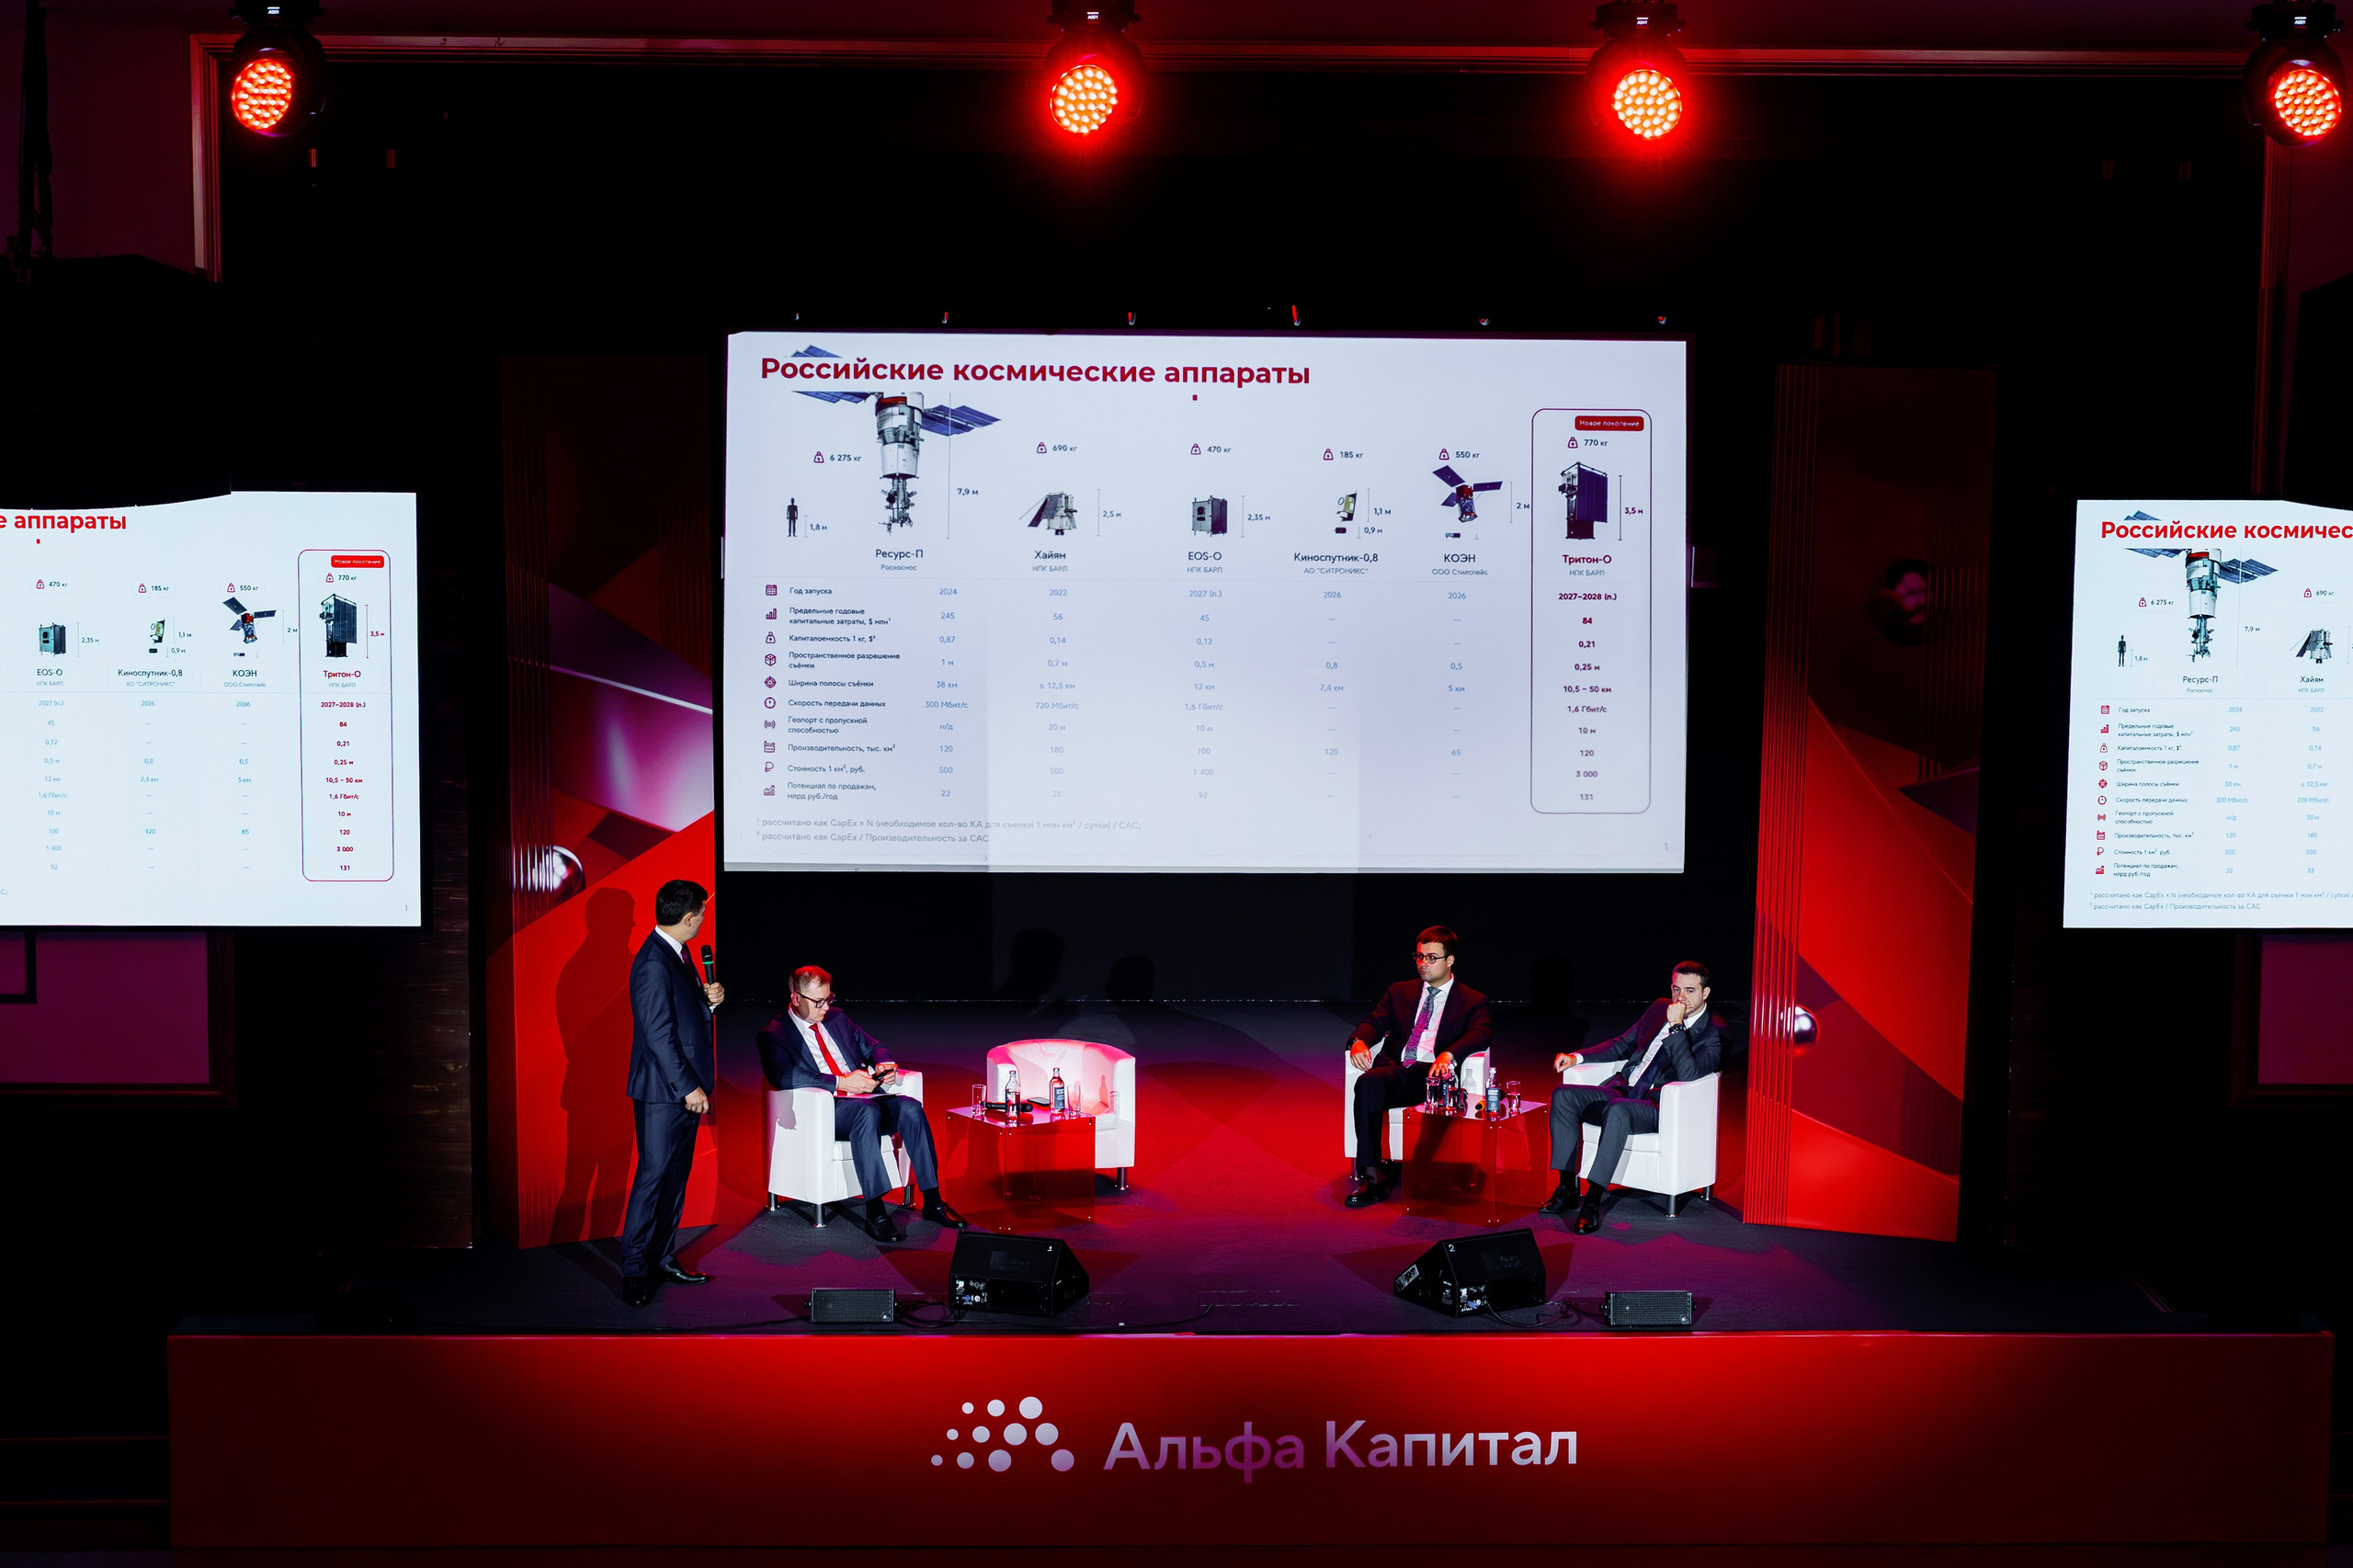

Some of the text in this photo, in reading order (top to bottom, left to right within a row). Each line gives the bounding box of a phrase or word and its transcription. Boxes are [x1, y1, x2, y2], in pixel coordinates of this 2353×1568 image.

[761, 357, 1310, 389] Российские космические аппараты
[1584, 438, 1599, 447] 770
[1051, 444, 1068, 452] 690
[1207, 445, 1222, 453] 470
[836, 454, 852, 462] 275
[1339, 450, 1354, 459] 185
[1455, 450, 1471, 459] 550
[957, 487, 971, 496] 7,9
[1102, 510, 1115, 518] 2,5
[1624, 506, 1637, 516] 3,5
[1247, 513, 1264, 522] 2,35
[14, 516, 127, 534] аппараты
[2101, 520, 2353, 540] Российские космичес
[875, 549, 924, 561] Ресурс-П
[1034, 550, 1066, 560] Хайям
[1188, 551, 1222, 562] EOS-O
[1293, 552, 1379, 564] Киноспутник-0,8
[1444, 553, 1476, 563] КОЭН
[1562, 554, 1612, 566] Тритон-О
[1451, 568, 1488, 576] Стилспейс
[1586, 569, 1605, 578] БАРЛ
[789, 586, 833, 597] Год запуска
[938, 587, 958, 596] 2024
[1049, 588, 1068, 597] 2022
[1188, 589, 1208, 597] 2027
[1323, 591, 1342, 599] 2026
[1448, 591, 1467, 600] 2026
[789, 607, 834, 615] Предельные
[940, 611, 955, 619] 245
[1052, 612, 1063, 620] 56
[1199, 614, 1210, 622] 45
[1582, 617, 1593, 625] 84
[938, 635, 956, 644] 0,87
[1049, 636, 1066, 645] 0,14
[1196, 637, 1213, 646] 0,12
[1578, 640, 1596, 649] 0,21
[789, 651, 856, 660] Пространственное
[1325, 661, 1338, 670] 0,8
[1449, 662, 1463, 671] 0,5
[1574, 663, 1593, 672] 0,25
[118, 668, 183, 679] Киноспутник-0,8
[233, 669, 257, 677] КОЭН
[323, 670, 361, 679] Тритон-О
[788, 679, 818, 688] Ширина
[936, 680, 946, 688] 38
[2182, 676, 2219, 685] Ресурс-П
[2300, 676, 2324, 684] Хайям
[1320, 683, 1332, 692] 7,4
[1563, 685, 1580, 694] 10,5
[1589, 685, 1600, 693] 50
[788, 699, 824, 708] Скорость
[925, 700, 969, 709] 300 Мбит/с
[1567, 705, 1608, 714] 1,6 Гбит/с
[788, 715, 818, 725] Геопорт
[824, 717, 868, 725] пропускной
[787, 726, 839, 734] способностью
[939, 722, 954, 731] н/д
[788, 744, 865, 753] Производительность,
[939, 744, 954, 753] 120
[1324, 747, 1339, 756] 120
[1451, 748, 1461, 756] 65
[1579, 749, 1595, 757] 120
[787, 764, 827, 773] Стоимость
[849, 765, 866, 775] руб.
[938, 766, 954, 774] 500
[1583, 770, 1598, 778] 000
[787, 781, 826, 790] Потенциал
[807, 792, 838, 801] руб./год
[940, 789, 951, 798] 22
[1104, 1420, 1578, 1483] Альфа Капитал
